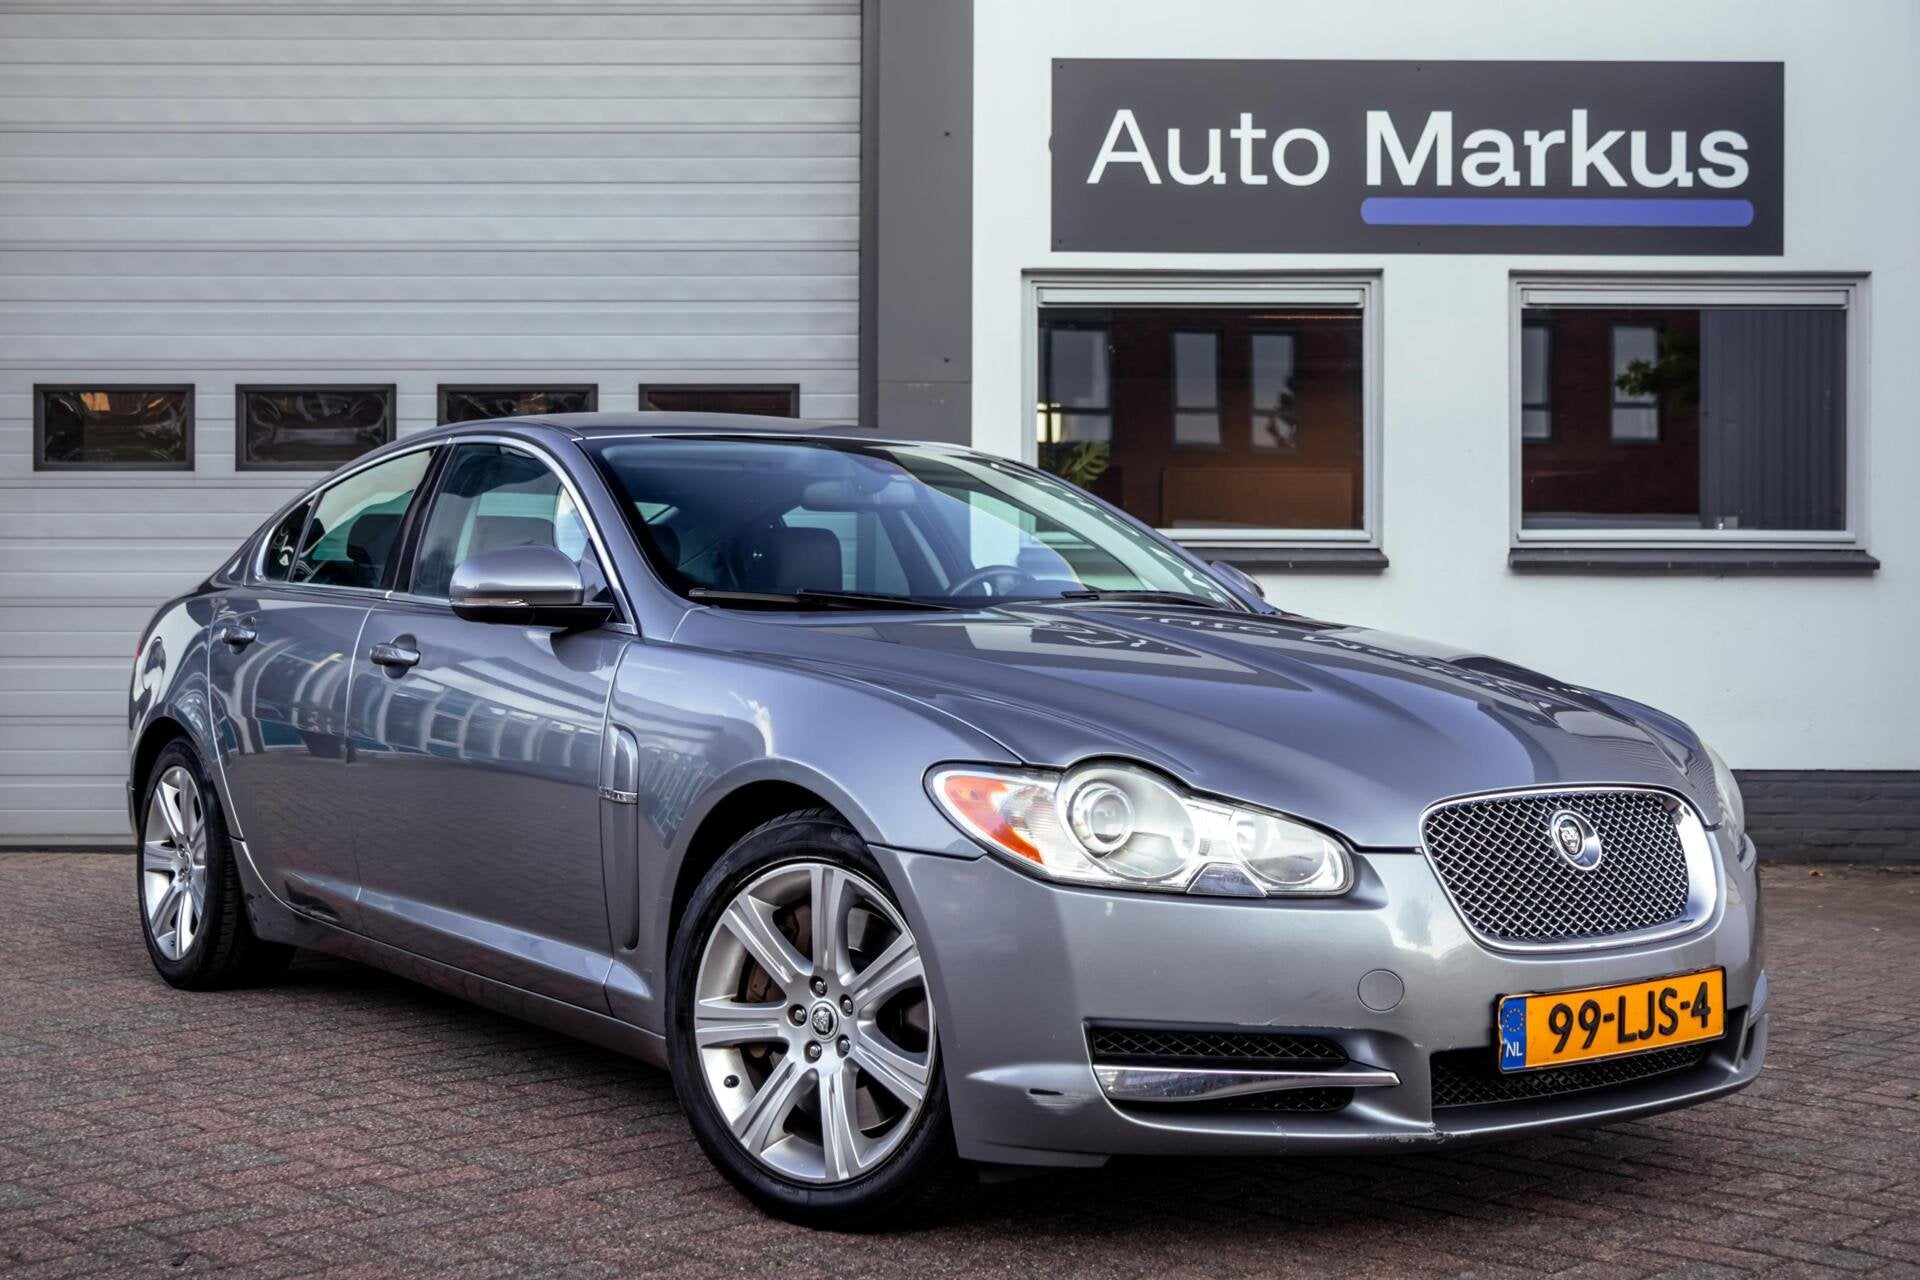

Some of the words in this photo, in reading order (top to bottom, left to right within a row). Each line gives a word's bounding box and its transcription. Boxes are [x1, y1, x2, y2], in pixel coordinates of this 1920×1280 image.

[1086, 109, 1330, 187] Auto
[1366, 109, 1750, 190] Markus
[1505, 1041, 1523, 1058] NL
[1548, 981, 1711, 1054] 99-LJS-4
